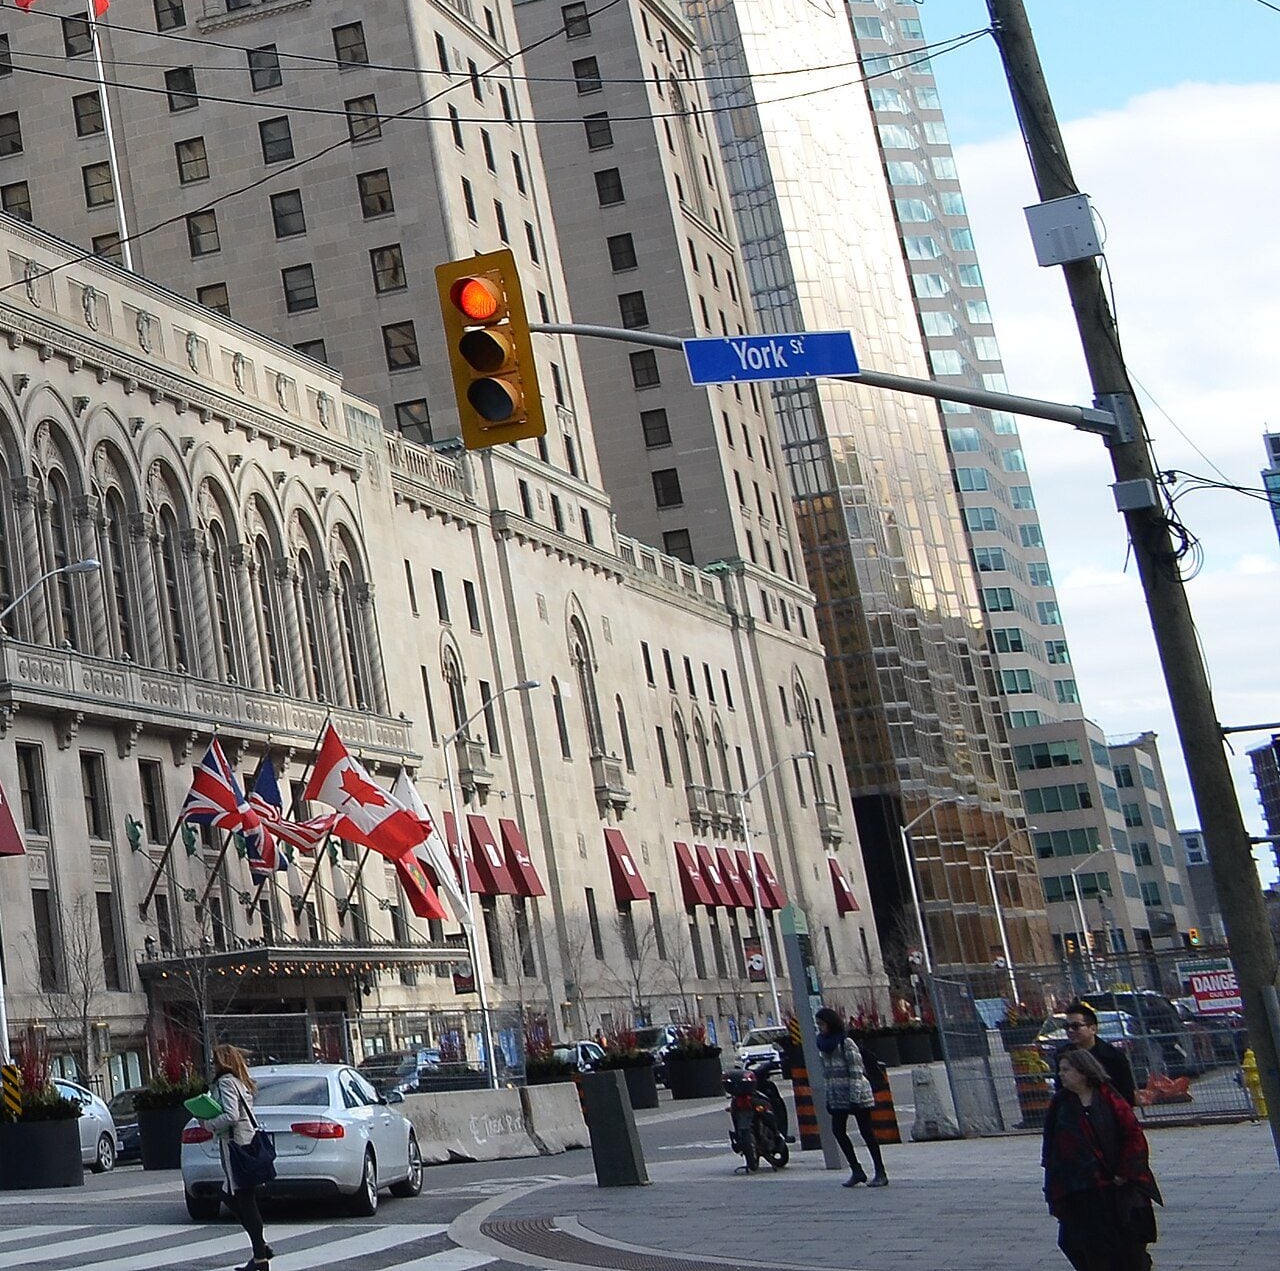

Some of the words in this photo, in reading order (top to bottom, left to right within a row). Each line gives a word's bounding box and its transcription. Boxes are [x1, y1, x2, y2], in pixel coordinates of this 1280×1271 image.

[731, 340, 788, 370] York
[790, 339, 805, 354] St
[1192, 974, 1238, 993] DANGE
